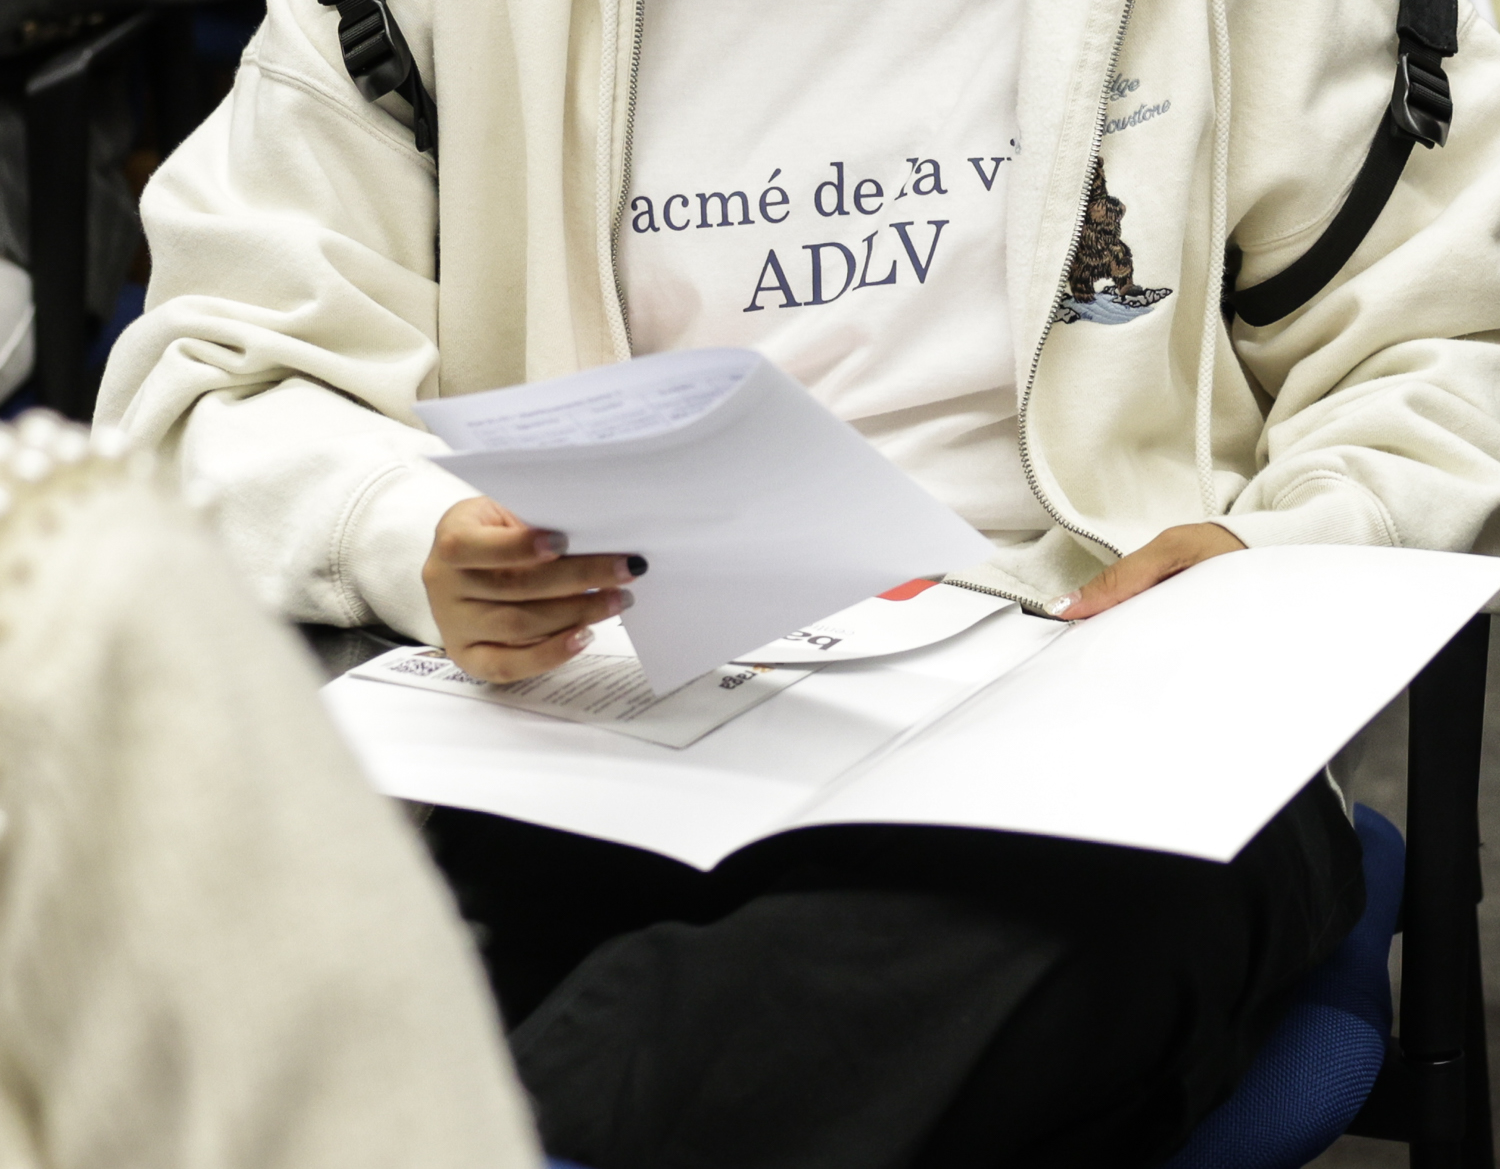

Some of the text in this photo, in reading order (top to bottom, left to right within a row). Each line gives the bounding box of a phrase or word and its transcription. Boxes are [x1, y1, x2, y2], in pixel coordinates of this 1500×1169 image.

[630, 167, 791, 234] acmé
[813, 161, 884, 218] de
[742, 219, 950, 313] ADLV
[782, 629, 844, 651] ba
